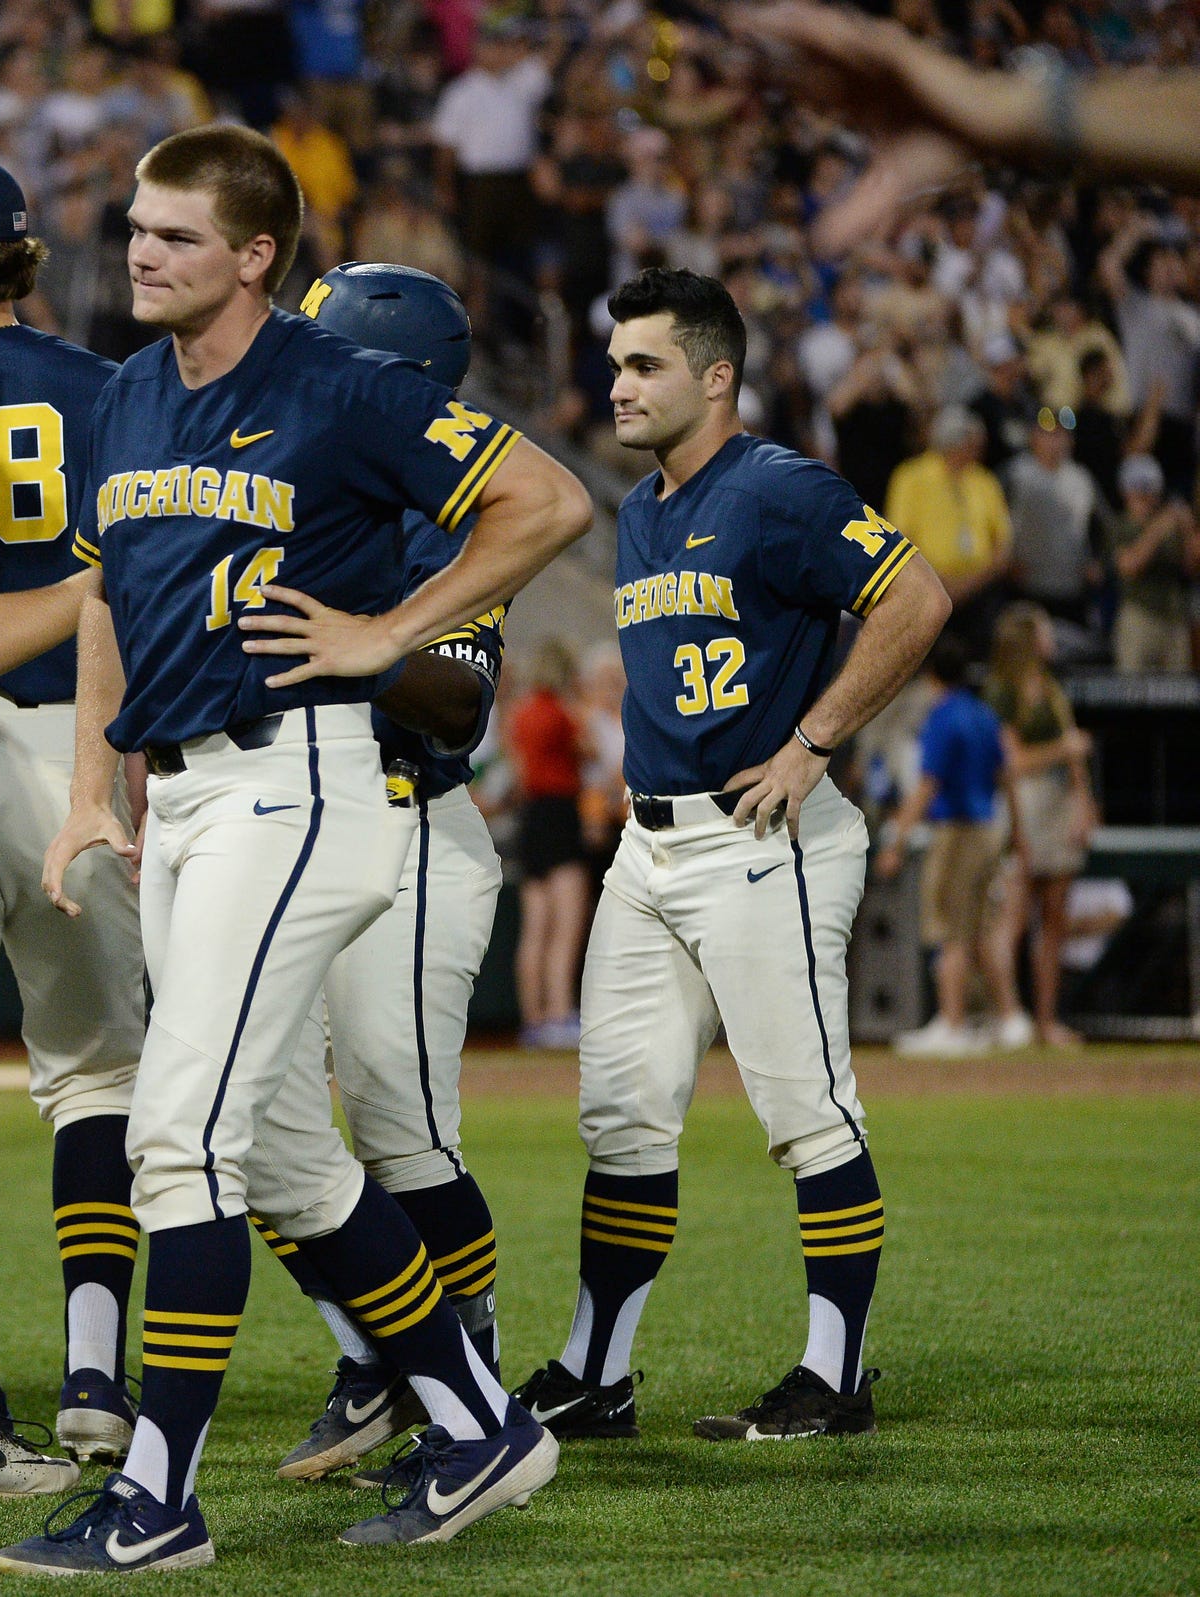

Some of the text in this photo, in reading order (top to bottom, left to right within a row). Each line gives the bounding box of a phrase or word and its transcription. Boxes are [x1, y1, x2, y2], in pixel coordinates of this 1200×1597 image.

[300, 277, 333, 320] M
[424, 400, 493, 462] M
[96, 465, 296, 537] MICHIGAN
[841, 504, 898, 558] M
[205, 546, 285, 632] 14
[613, 570, 741, 630] CHIGAN
[427, 643, 489, 670] AHA
[673, 636, 749, 717] 32
[110, 1479, 140, 1500] NIKE
